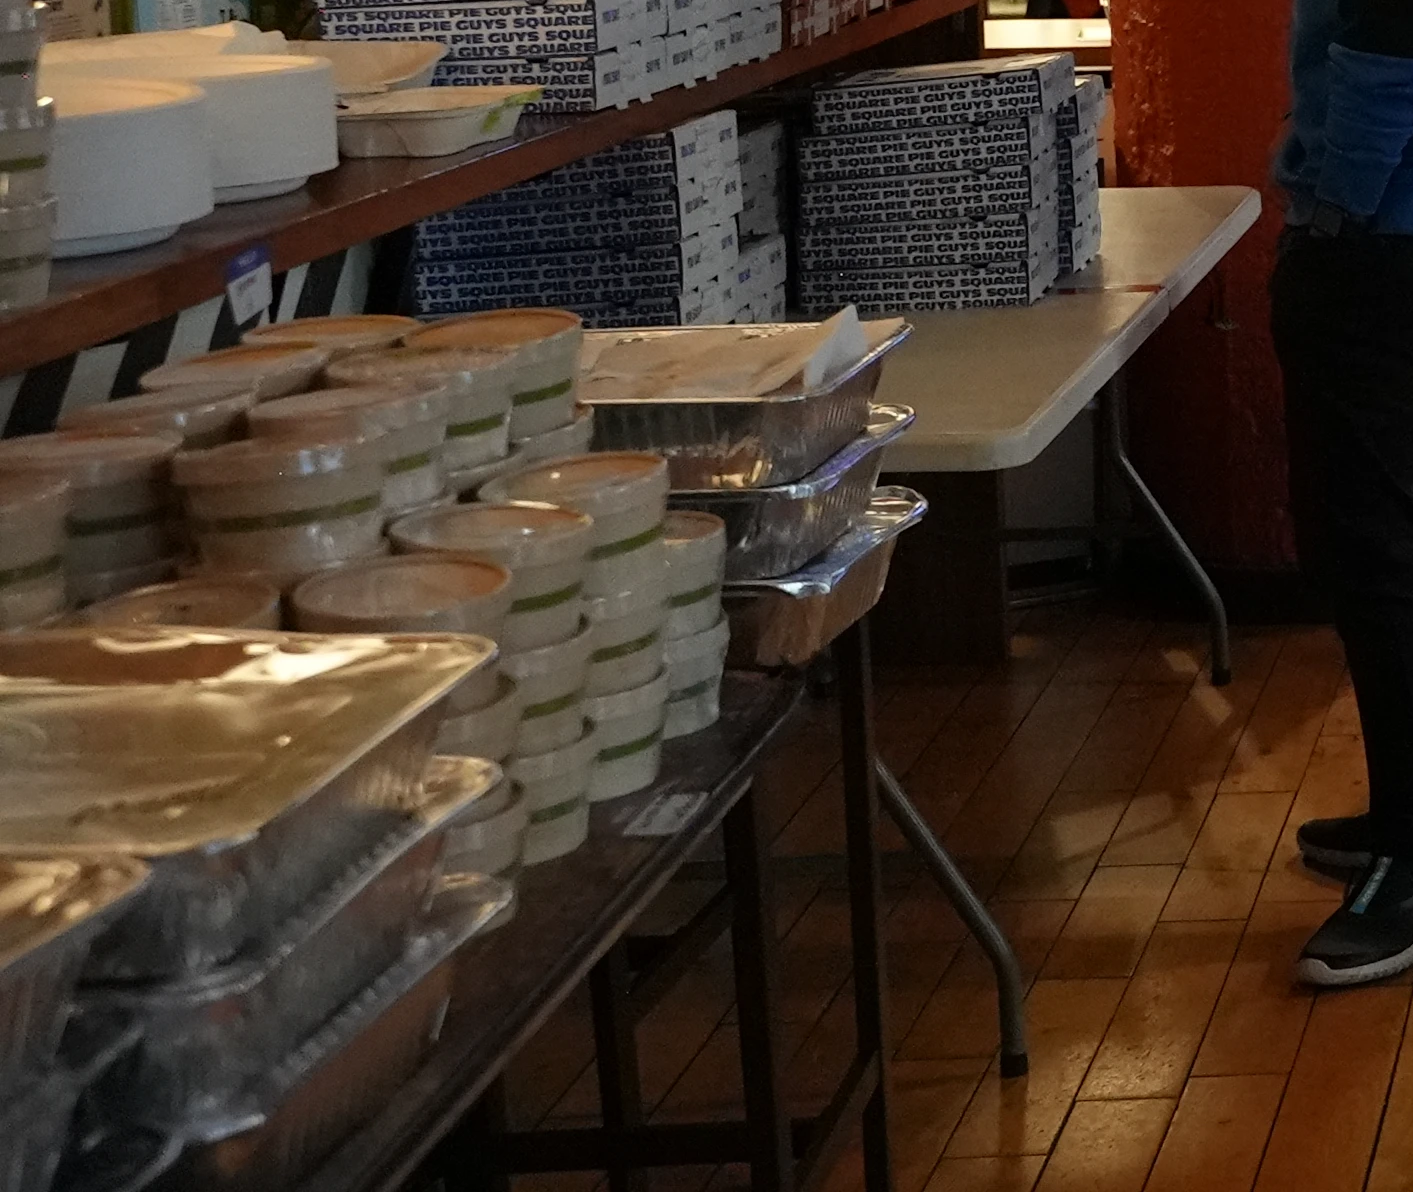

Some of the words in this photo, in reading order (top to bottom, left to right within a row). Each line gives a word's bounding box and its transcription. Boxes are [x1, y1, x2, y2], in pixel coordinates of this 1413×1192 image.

[335, 22, 415, 35] SQUARE
[420, 21, 451, 31] PIE
[455, 18, 506, 30] GUYS
[512, 14, 592, 27] SQUARE
[451, 34, 483, 44] PIE
[488, 31, 538, 43] GUYS
[458, 45, 509, 57] GUYS
[515, 41, 596, 54] SQUARE
[447, 65, 478, 75] PIE
[482, 62, 534, 74] GUYS
[826, 98, 889, 111] SQUARE
[895, 95, 919, 105] PIE
[924, 91, 965, 102] GUYS
[971, 84, 1038, 98] SQUARE
[522, 99, 593, 114] QUARE
